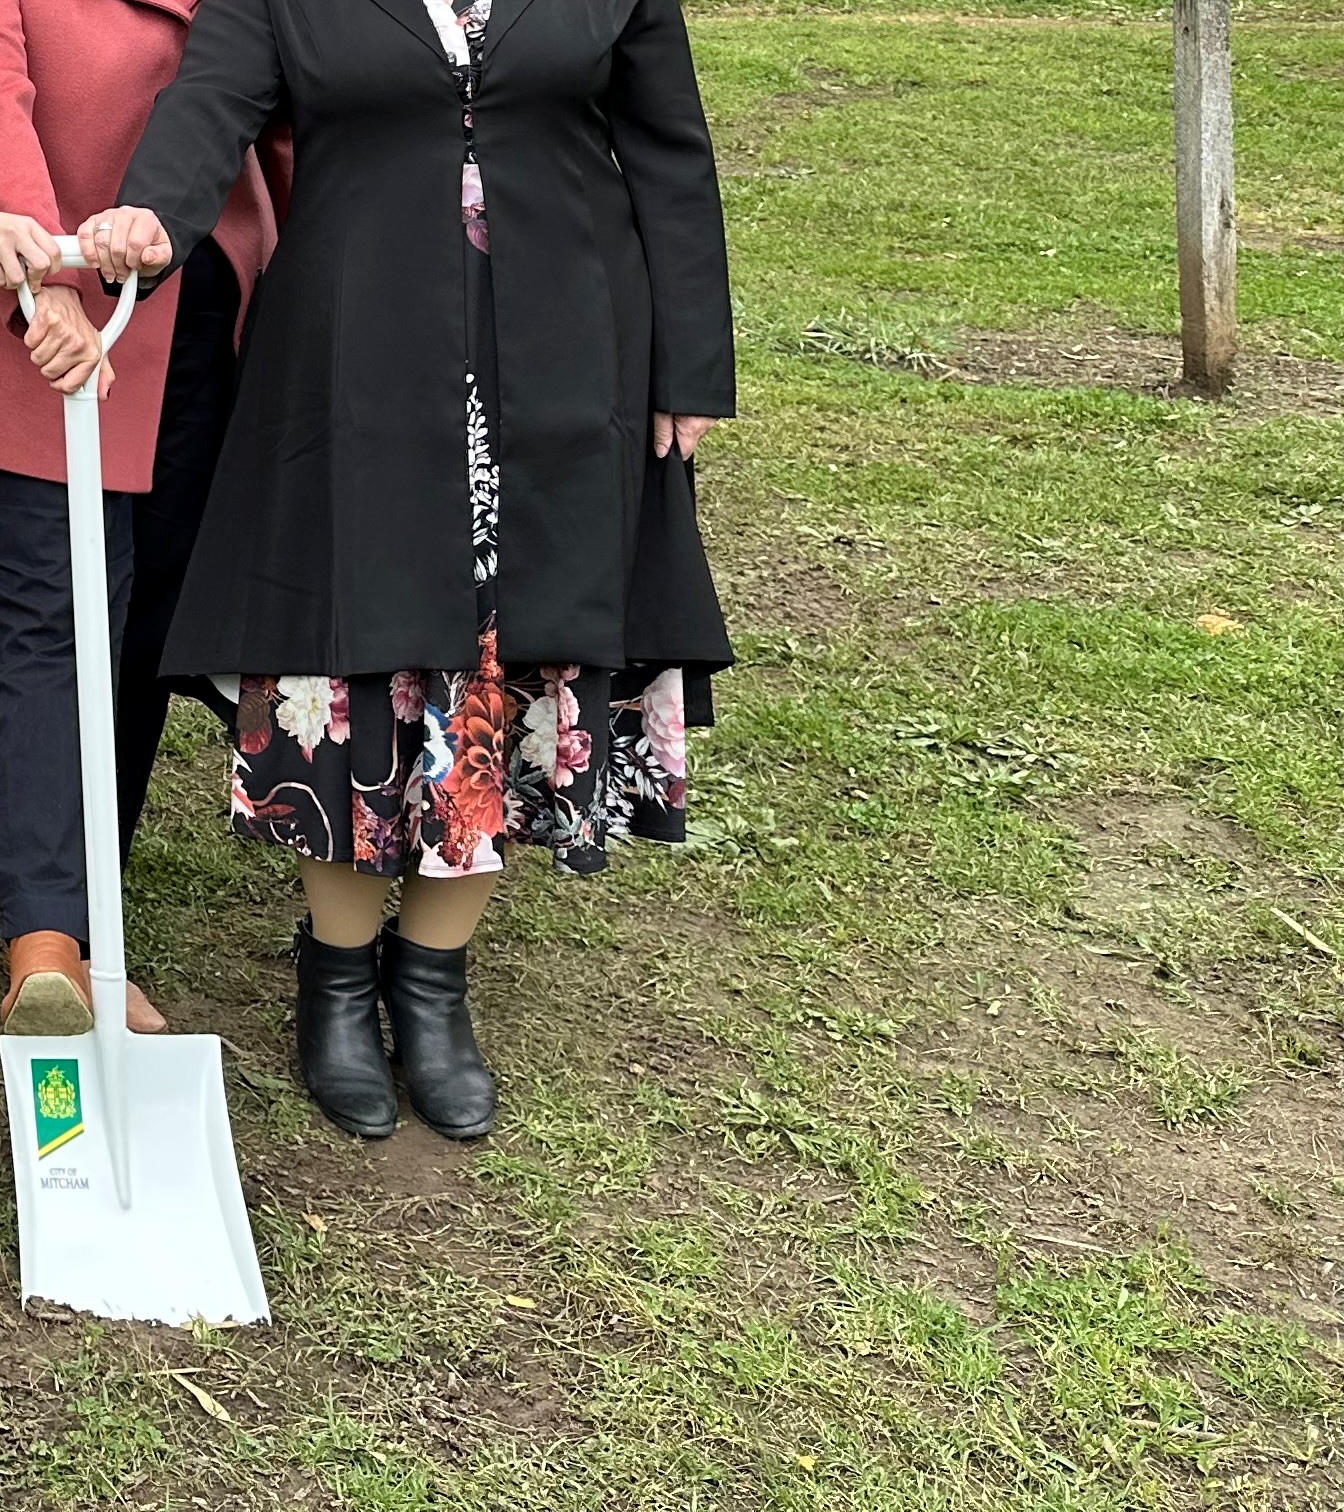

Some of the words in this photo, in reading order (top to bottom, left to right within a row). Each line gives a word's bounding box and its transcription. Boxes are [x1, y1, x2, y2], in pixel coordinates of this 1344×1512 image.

[49, 1167, 65, 1176] CITY
[67, 1167, 77, 1176] OF
[40, 1177, 89, 1189] MITCHAM
